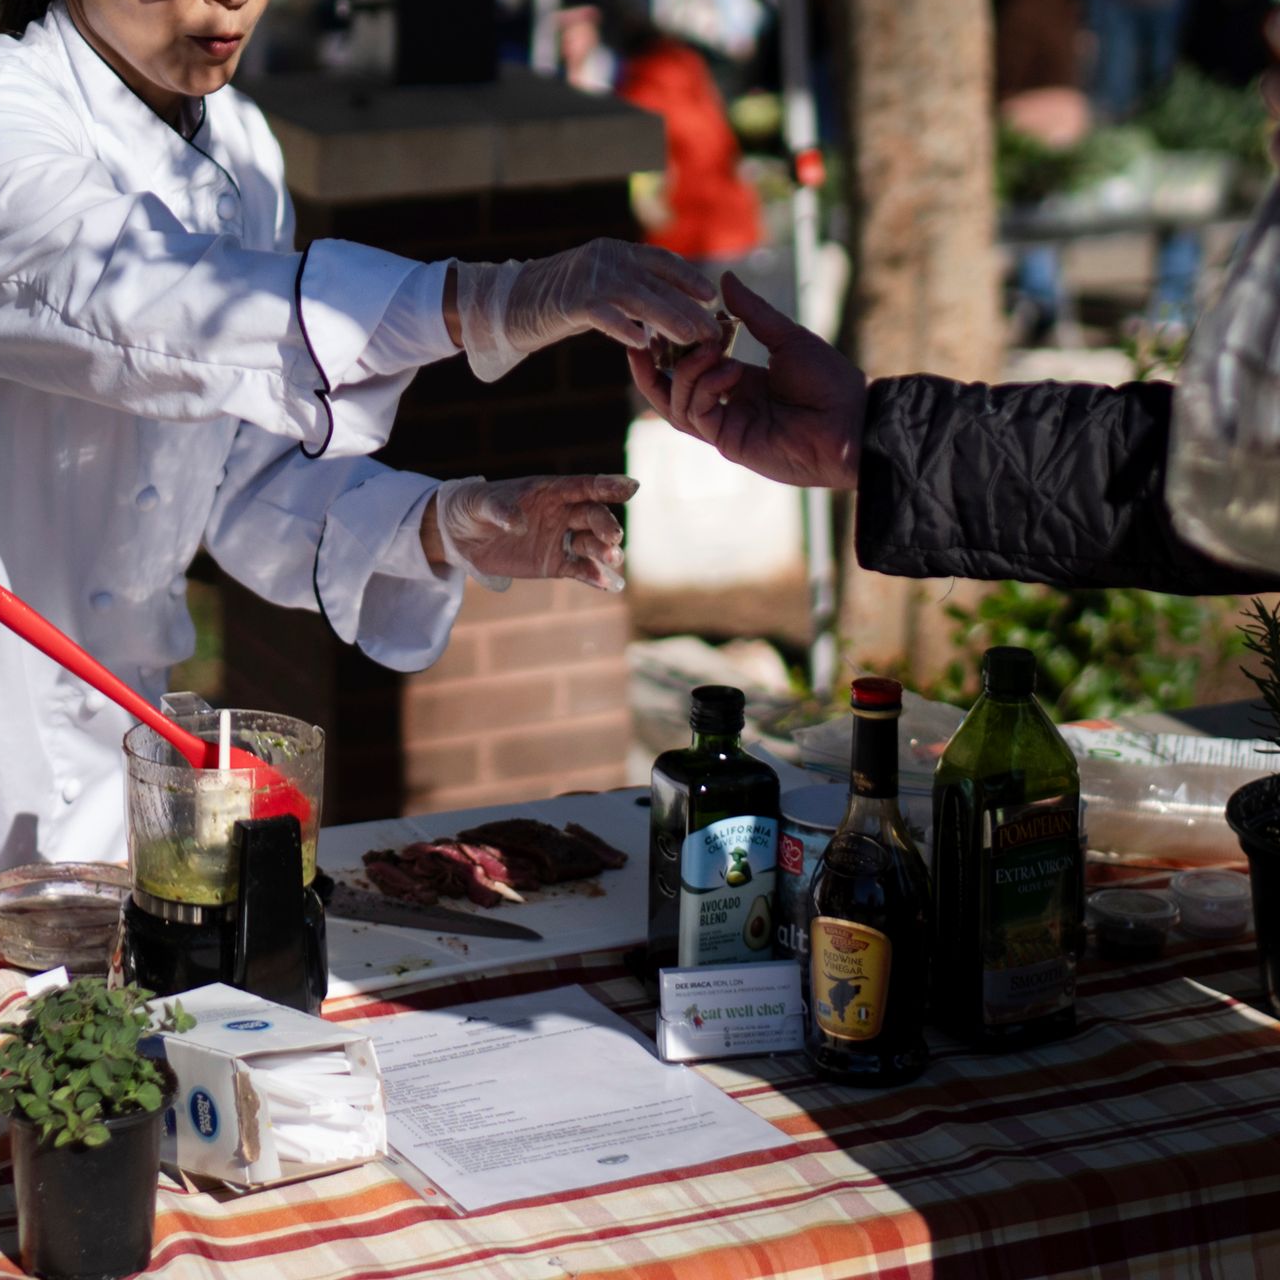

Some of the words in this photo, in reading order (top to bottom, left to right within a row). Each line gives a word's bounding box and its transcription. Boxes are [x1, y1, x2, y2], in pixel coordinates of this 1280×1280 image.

[704, 824, 772, 846] CALIFORNIA
[708, 837, 734, 854] OLIVE
[735, 834, 768, 848] RANCH
[995, 865, 1036, 884] EXTRA
[1036, 854, 1074, 876] VIRGIN
[700, 896, 740, 913] AVOCADO
[700, 911, 728, 926] BLEND
[777, 923, 809, 953] alt
[824, 959, 864, 976] VINEGAR
[839, 952, 863, 967] WINE
[701, 1008, 723, 1020] eat
[724, 1004, 754, 1019] well
[758, 1002, 786, 1017] chef
[202, 1099, 213, 1132] Total
